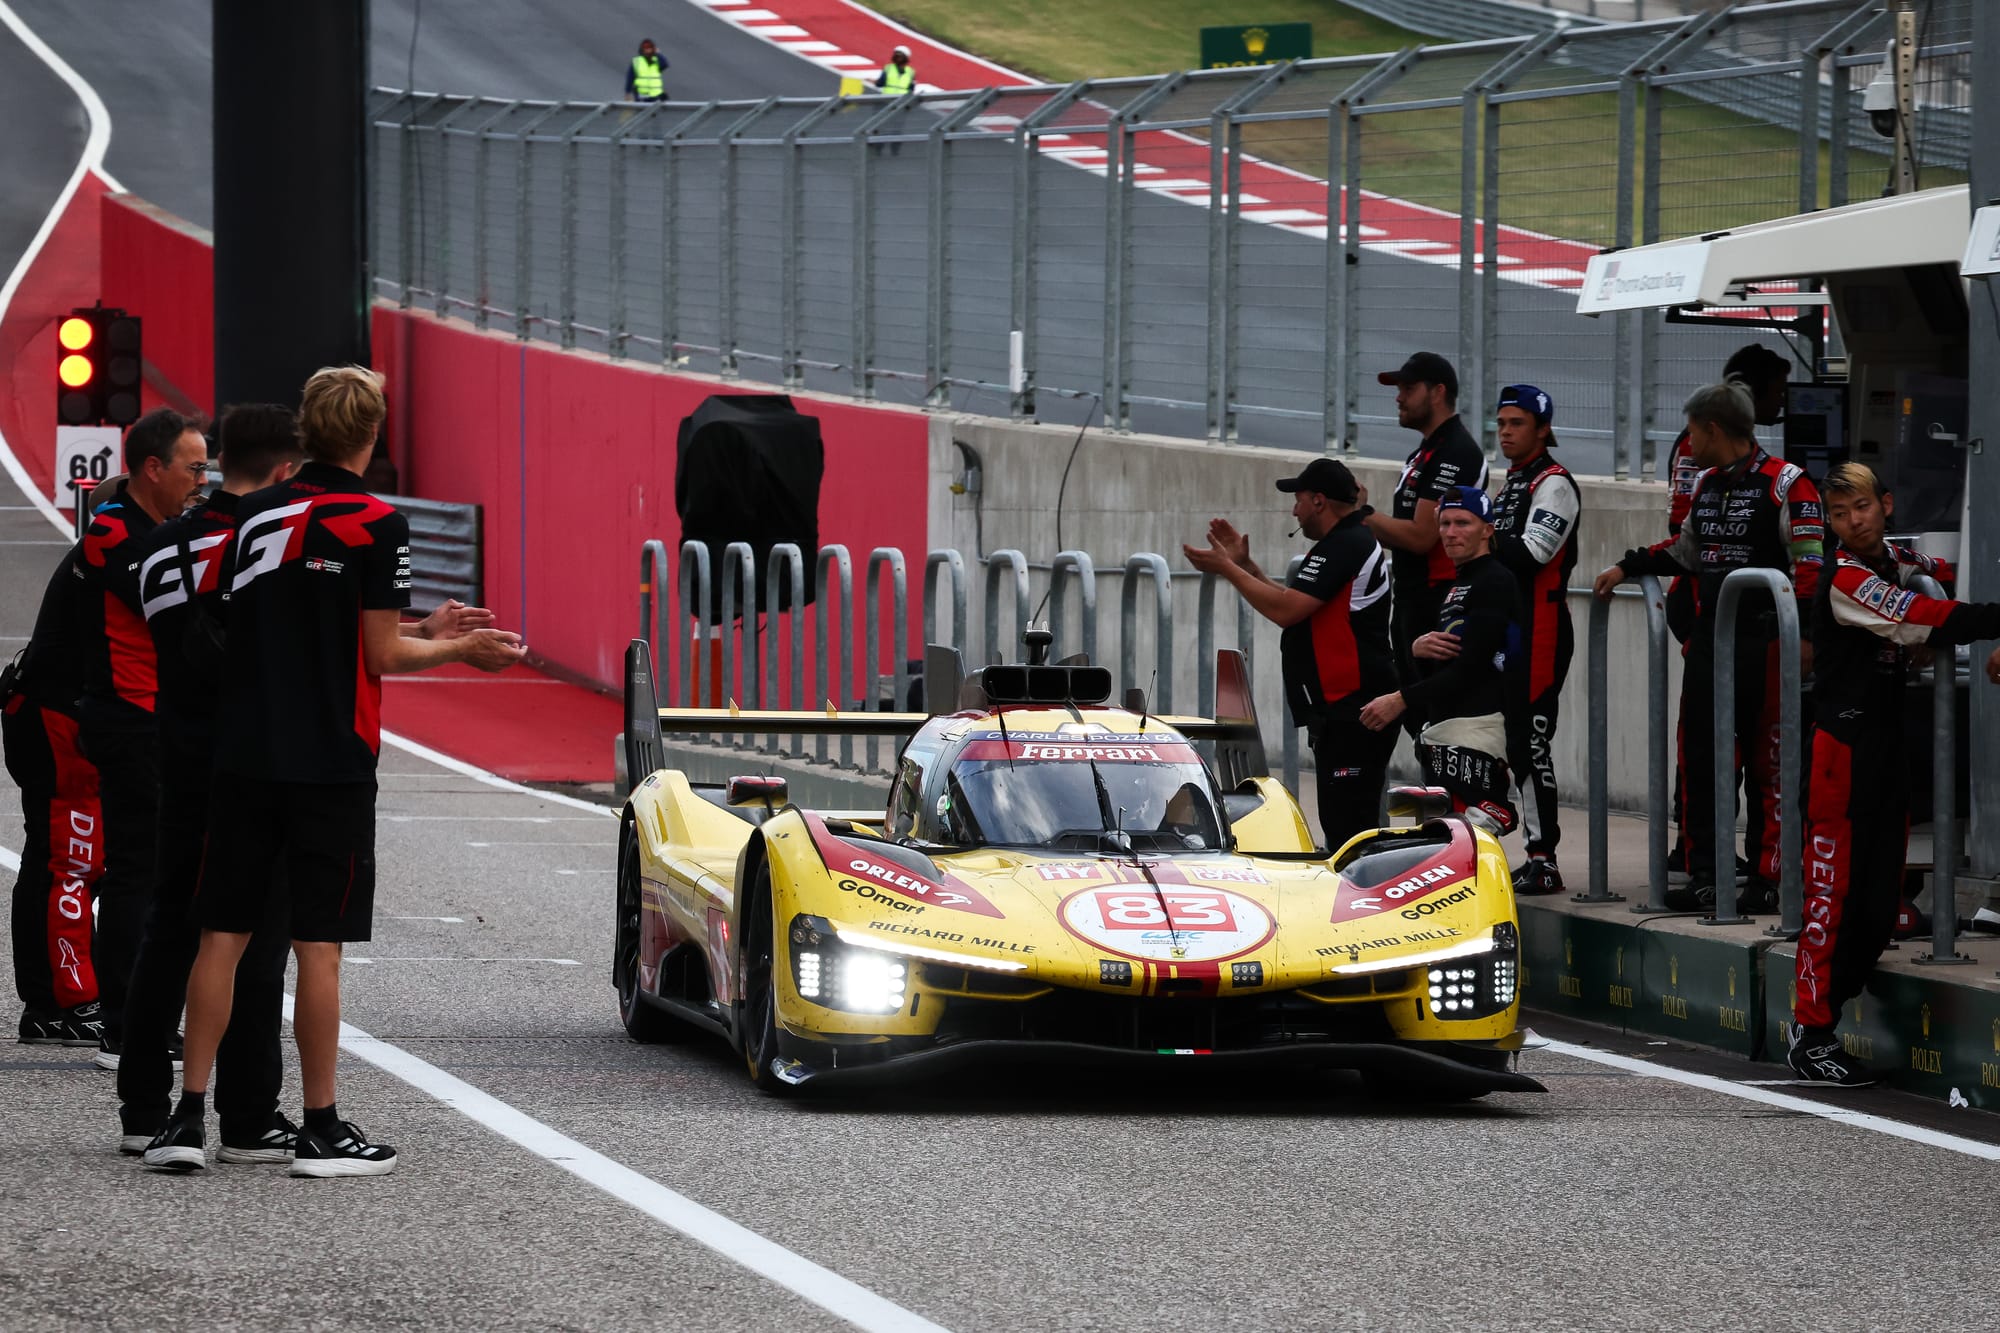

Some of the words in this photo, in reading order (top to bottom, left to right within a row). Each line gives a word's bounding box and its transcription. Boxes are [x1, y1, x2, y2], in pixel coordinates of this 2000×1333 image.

[69, 454, 108, 481] 60
[1700, 522, 1748, 536] DENSO
[1017, 742, 1163, 761] Ferrari
[1088, 733, 1150, 743] POZZI
[1530, 715, 1557, 789] DENSO
[57, 809, 95, 921] DENSO
[850, 859, 931, 896] ORLEN
[1040, 866, 1092, 880] HY
[1384, 864, 1457, 900] ORLEN
[1806, 834, 1836, 947] DENSO
[837, 878, 926, 916] GOmart
[1105, 896, 1228, 926] 83
[1400, 885, 1478, 921] GOmart
[867, 920, 965, 943] RICHARD
[970, 936, 1038, 955] MILLE
[1140, 930, 1207, 940] WEC
[1315, 936, 1402, 957] RICHARD
[1403, 926, 1463, 944] MILLE
[1558, 974, 1583, 999] ROLEX
[1608, 984, 1634, 1009] ROLEX
[1662, 994, 1688, 1021] ROLEX
[1719, 1005, 1747, 1033] ROLEX
[1844, 1032, 1874, 1061] ROLEX
[1911, 1046, 1944, 1075] ROLEX
[1981, 1062, 2000, 1089] ROL
